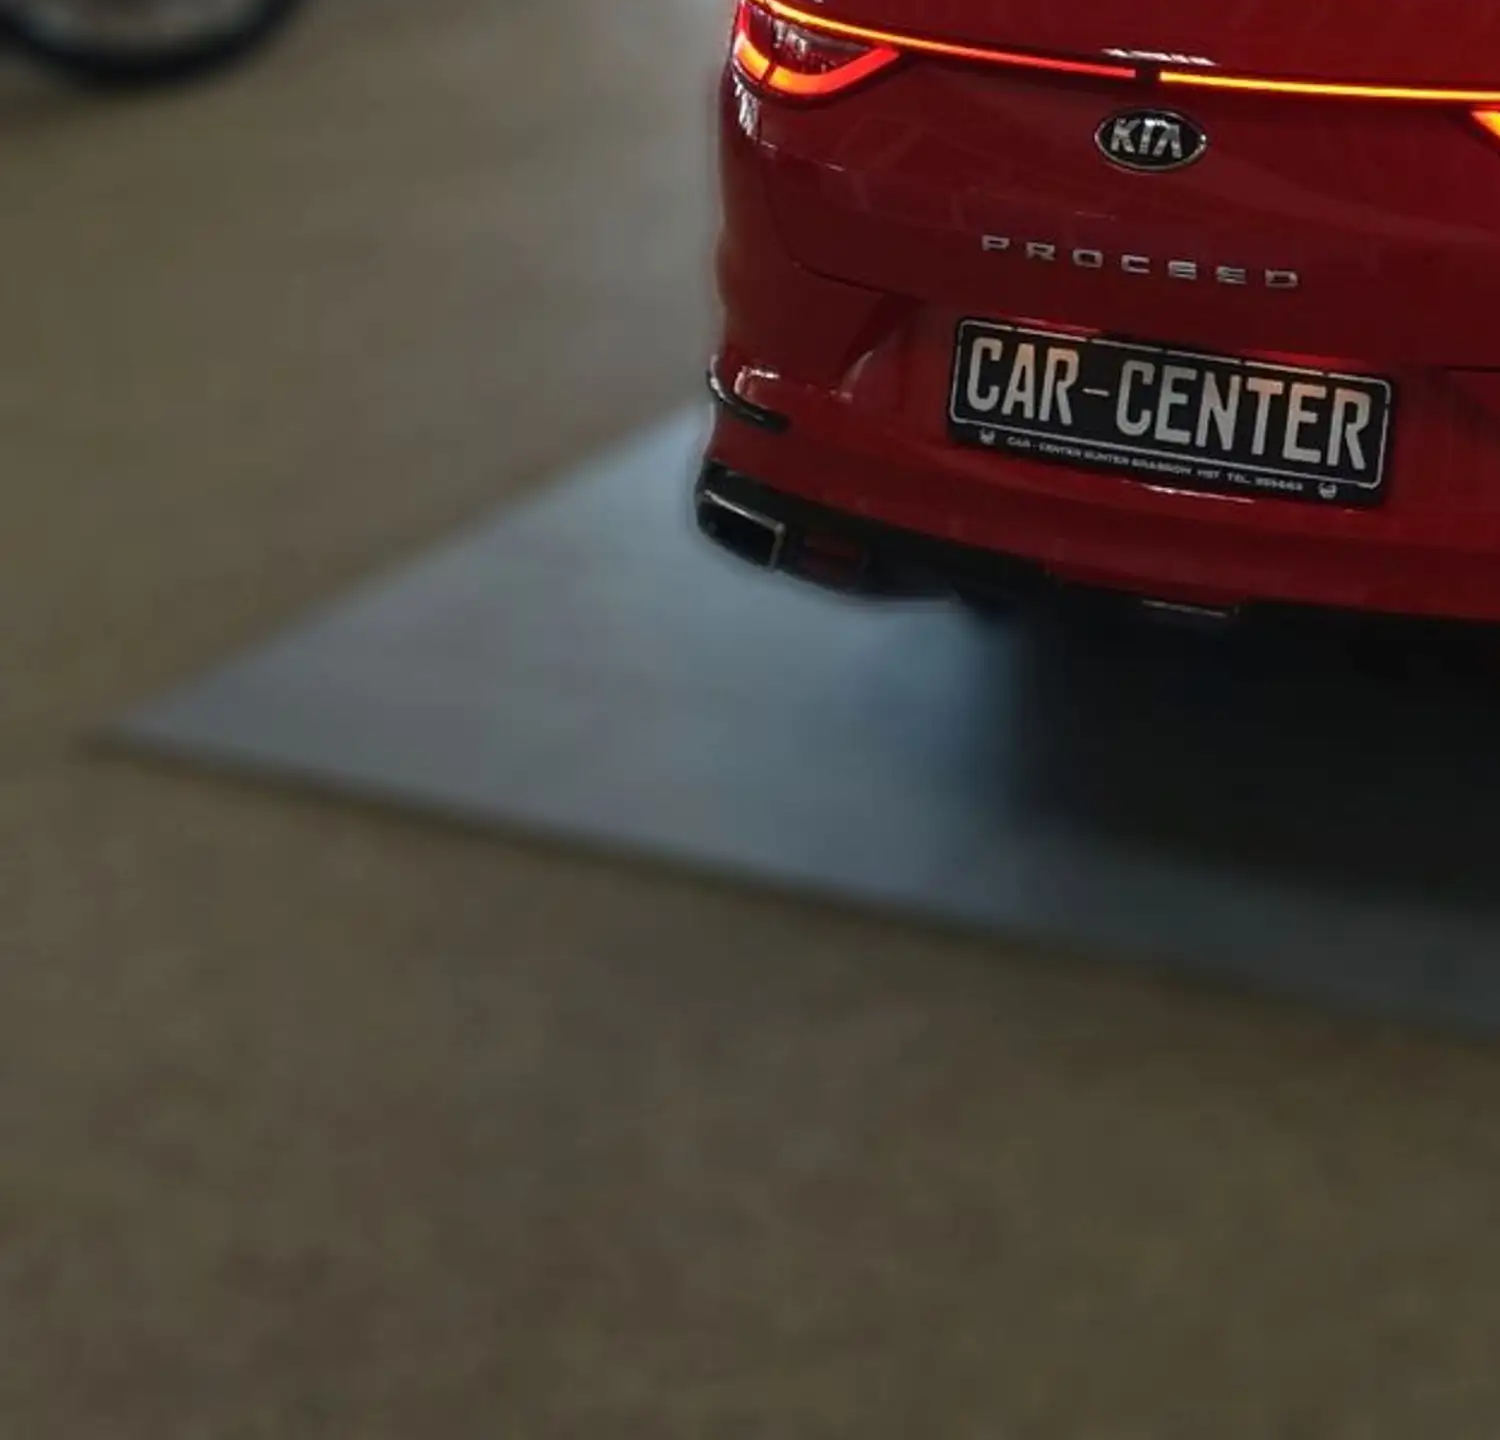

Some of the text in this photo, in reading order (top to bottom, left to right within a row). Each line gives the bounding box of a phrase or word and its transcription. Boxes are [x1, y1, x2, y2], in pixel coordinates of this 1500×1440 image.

[1110, 117, 1183, 159] KIA
[982, 234, 1298, 288] PROCEED
[966, 336, 1372, 471] CAR-CENTER
